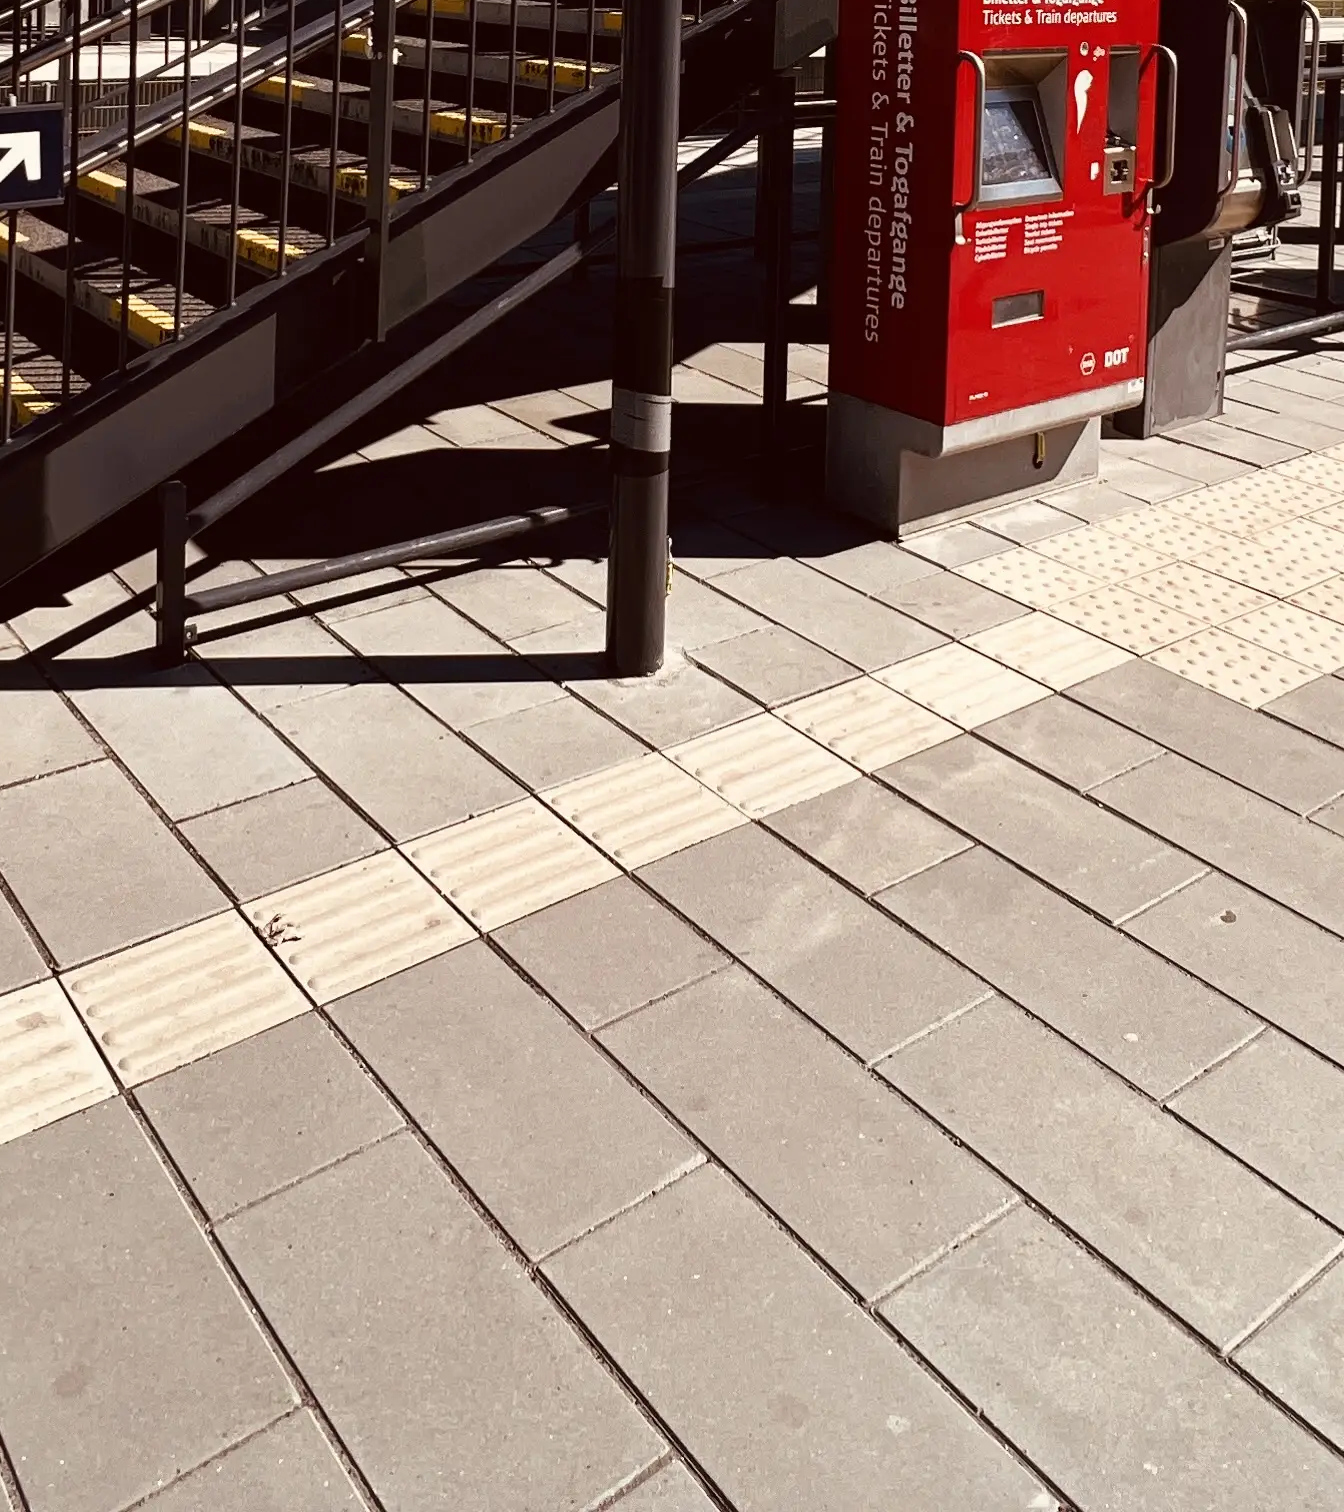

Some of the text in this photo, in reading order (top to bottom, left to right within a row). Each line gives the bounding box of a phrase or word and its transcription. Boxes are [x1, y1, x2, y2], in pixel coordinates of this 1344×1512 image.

[982, 8, 1118, 27] Tickets & Train departures
[871, 91, 890, 110] &
[895, 111, 915, 133] &
[869, 121, 889, 186] Train
[888, 142, 914, 309] Togafgange
[864, 196, 888, 343] departures
[1104, 347, 1130, 368] DOT
